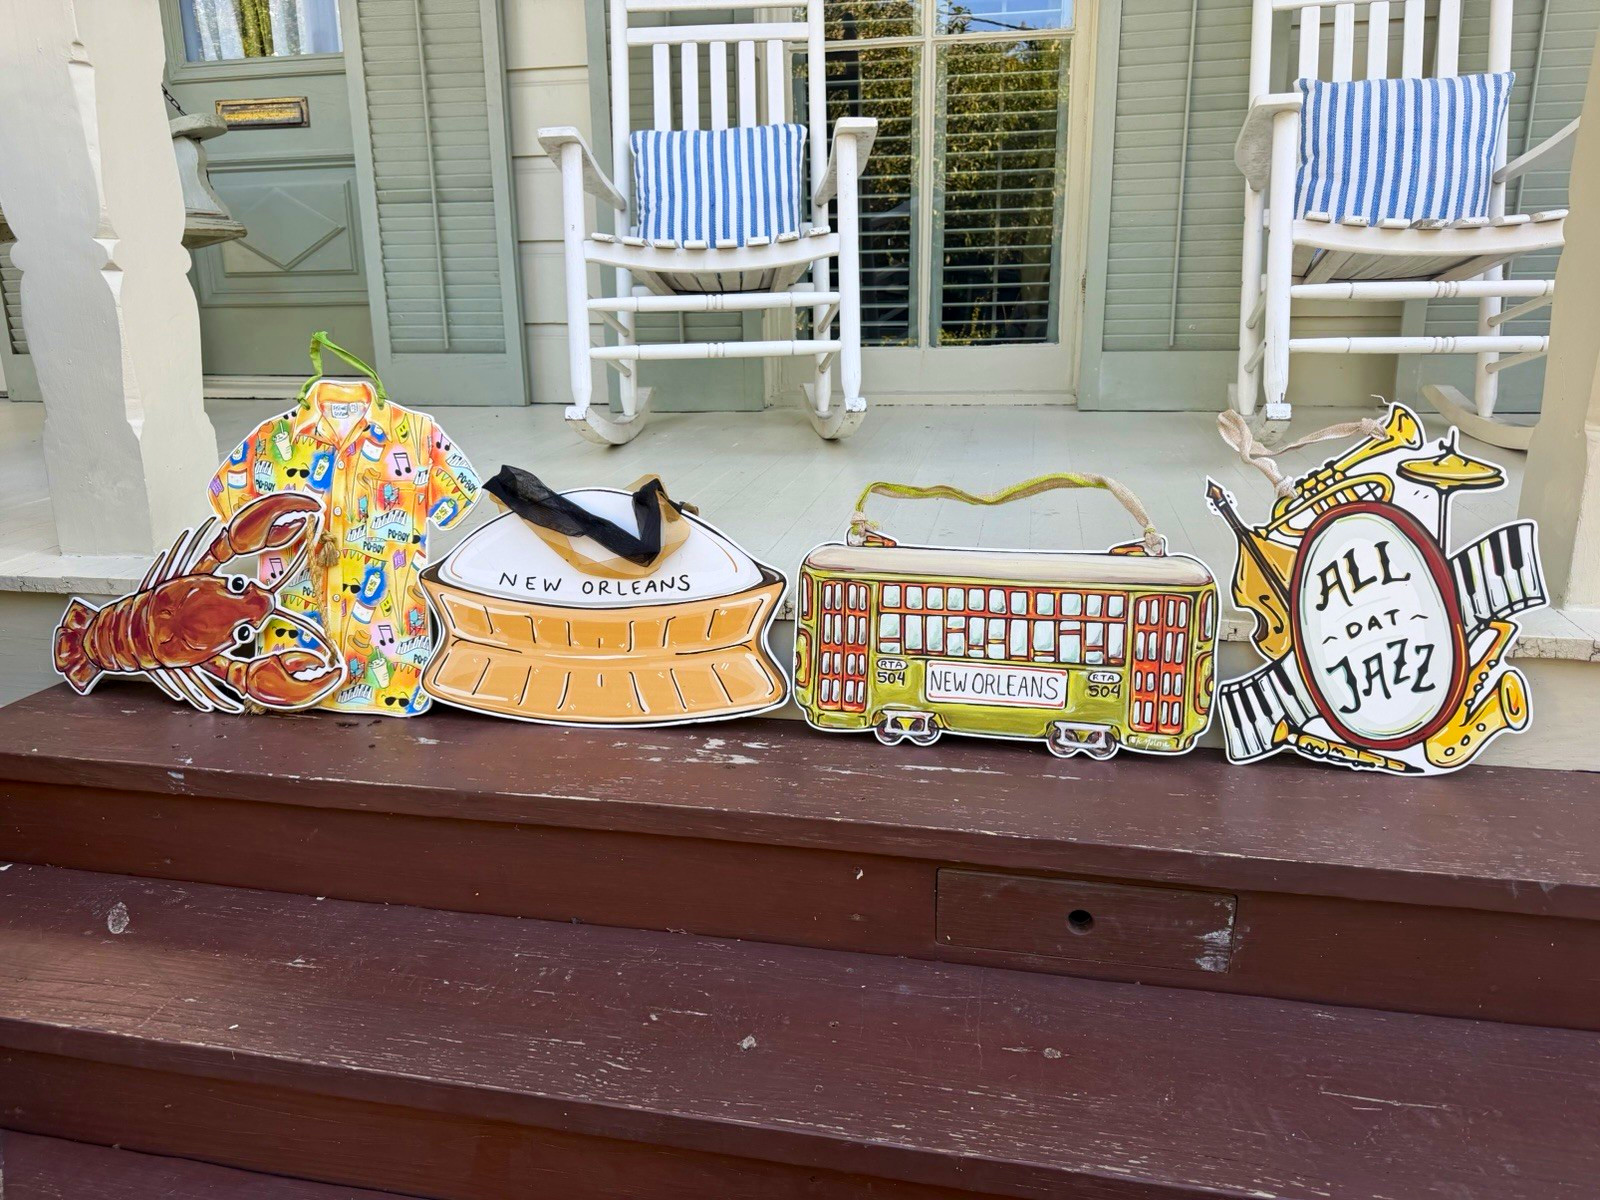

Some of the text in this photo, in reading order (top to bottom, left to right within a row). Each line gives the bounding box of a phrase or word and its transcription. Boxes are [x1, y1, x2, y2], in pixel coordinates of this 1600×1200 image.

[255, 479, 276, 493] PO-BOY
[456, 472, 479, 494] PO-BOY
[387, 529, 411, 543] PO-BOY
[362, 541, 386, 555] PO-BOY
[499, 572, 691, 596] NEW ORLEANS
[1315, 541, 1412, 612] ALL
[1345, 608, 1401, 640] DAT
[880, 660, 904, 669] RTA
[877, 671, 906, 686] 504
[1092, 673, 1115, 682] RTA
[1325, 637, 1437, 714] JAZZ
[929, 669, 1060, 700] NEW ORLEANS
[1087, 684, 1122, 699] 504
